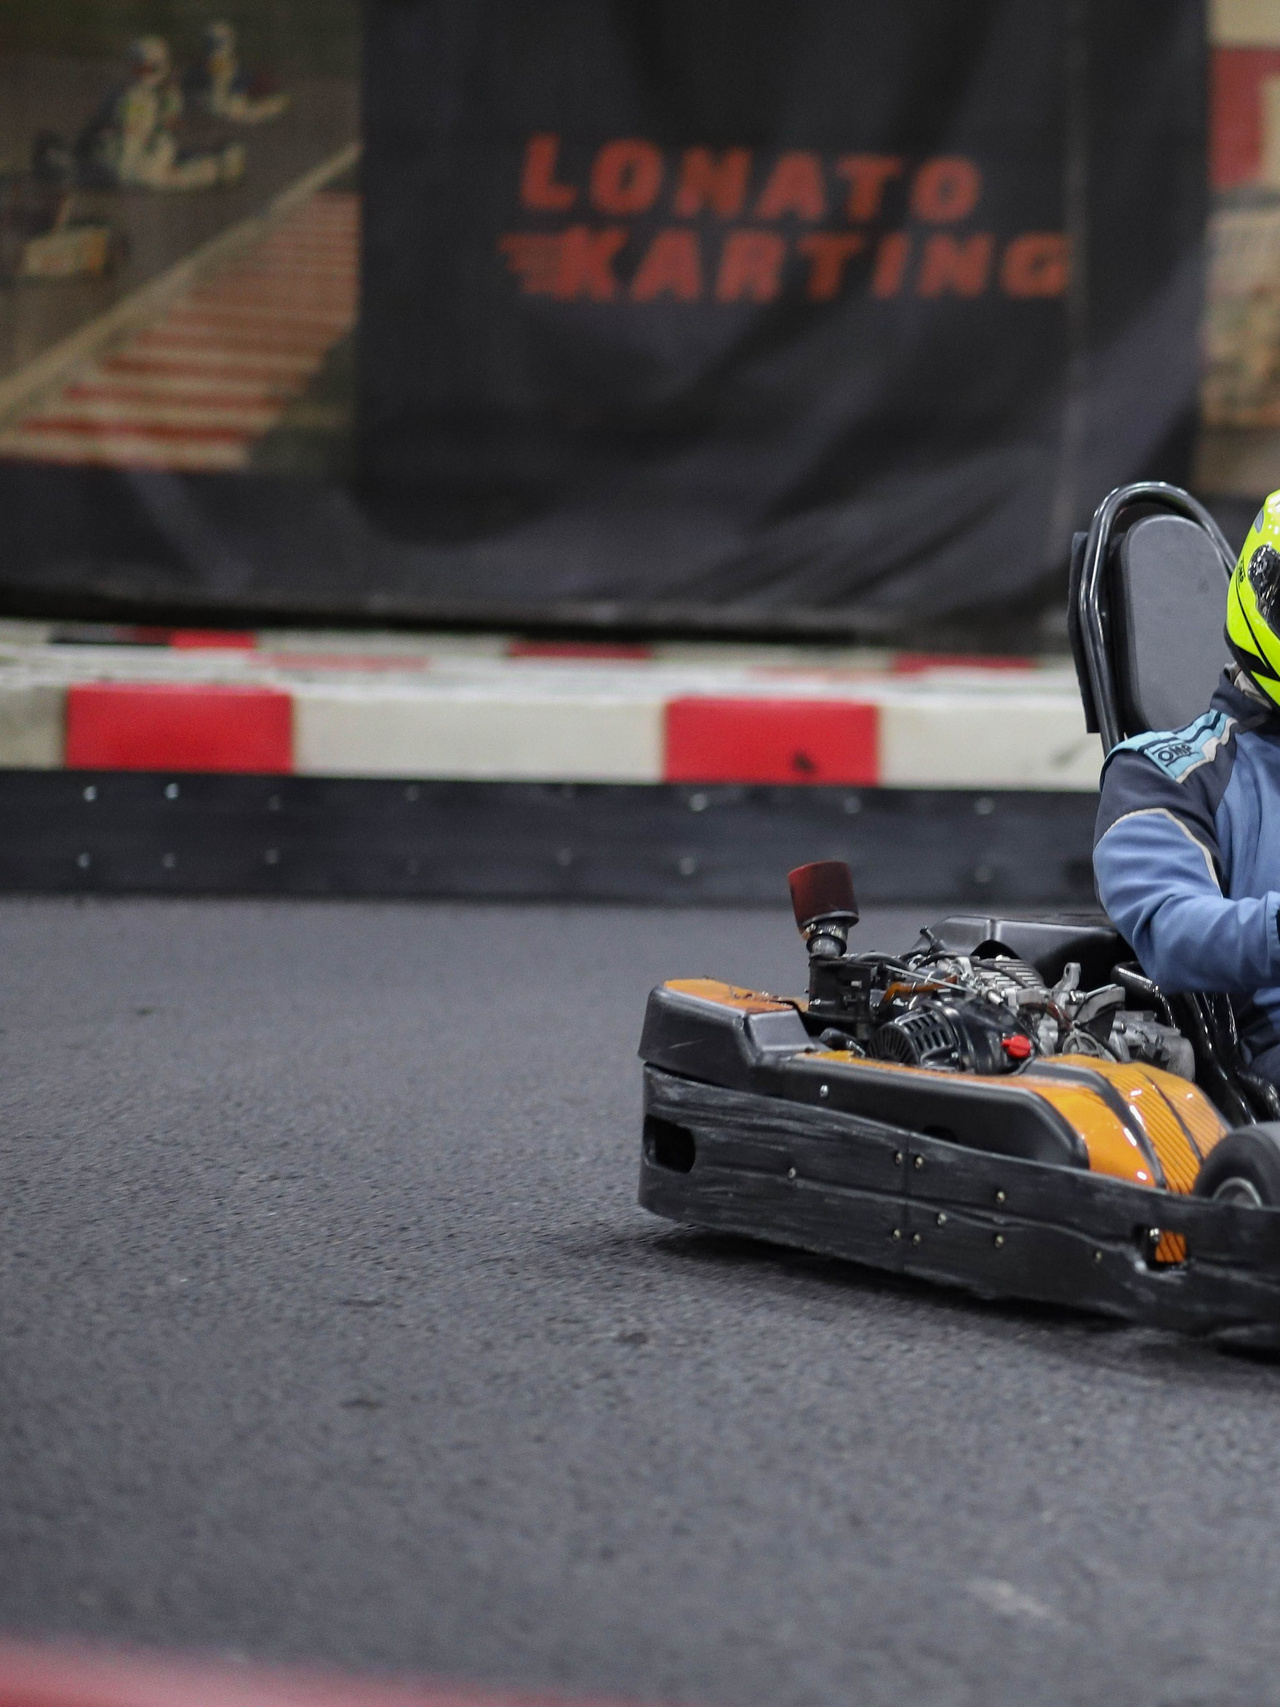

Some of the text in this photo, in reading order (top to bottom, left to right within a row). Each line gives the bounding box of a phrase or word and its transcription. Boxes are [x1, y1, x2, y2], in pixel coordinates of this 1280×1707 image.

[520, 133, 981, 222] LONATO
[550, 223, 1071, 301] KARTING
[1158, 744, 1192, 762] OMP
